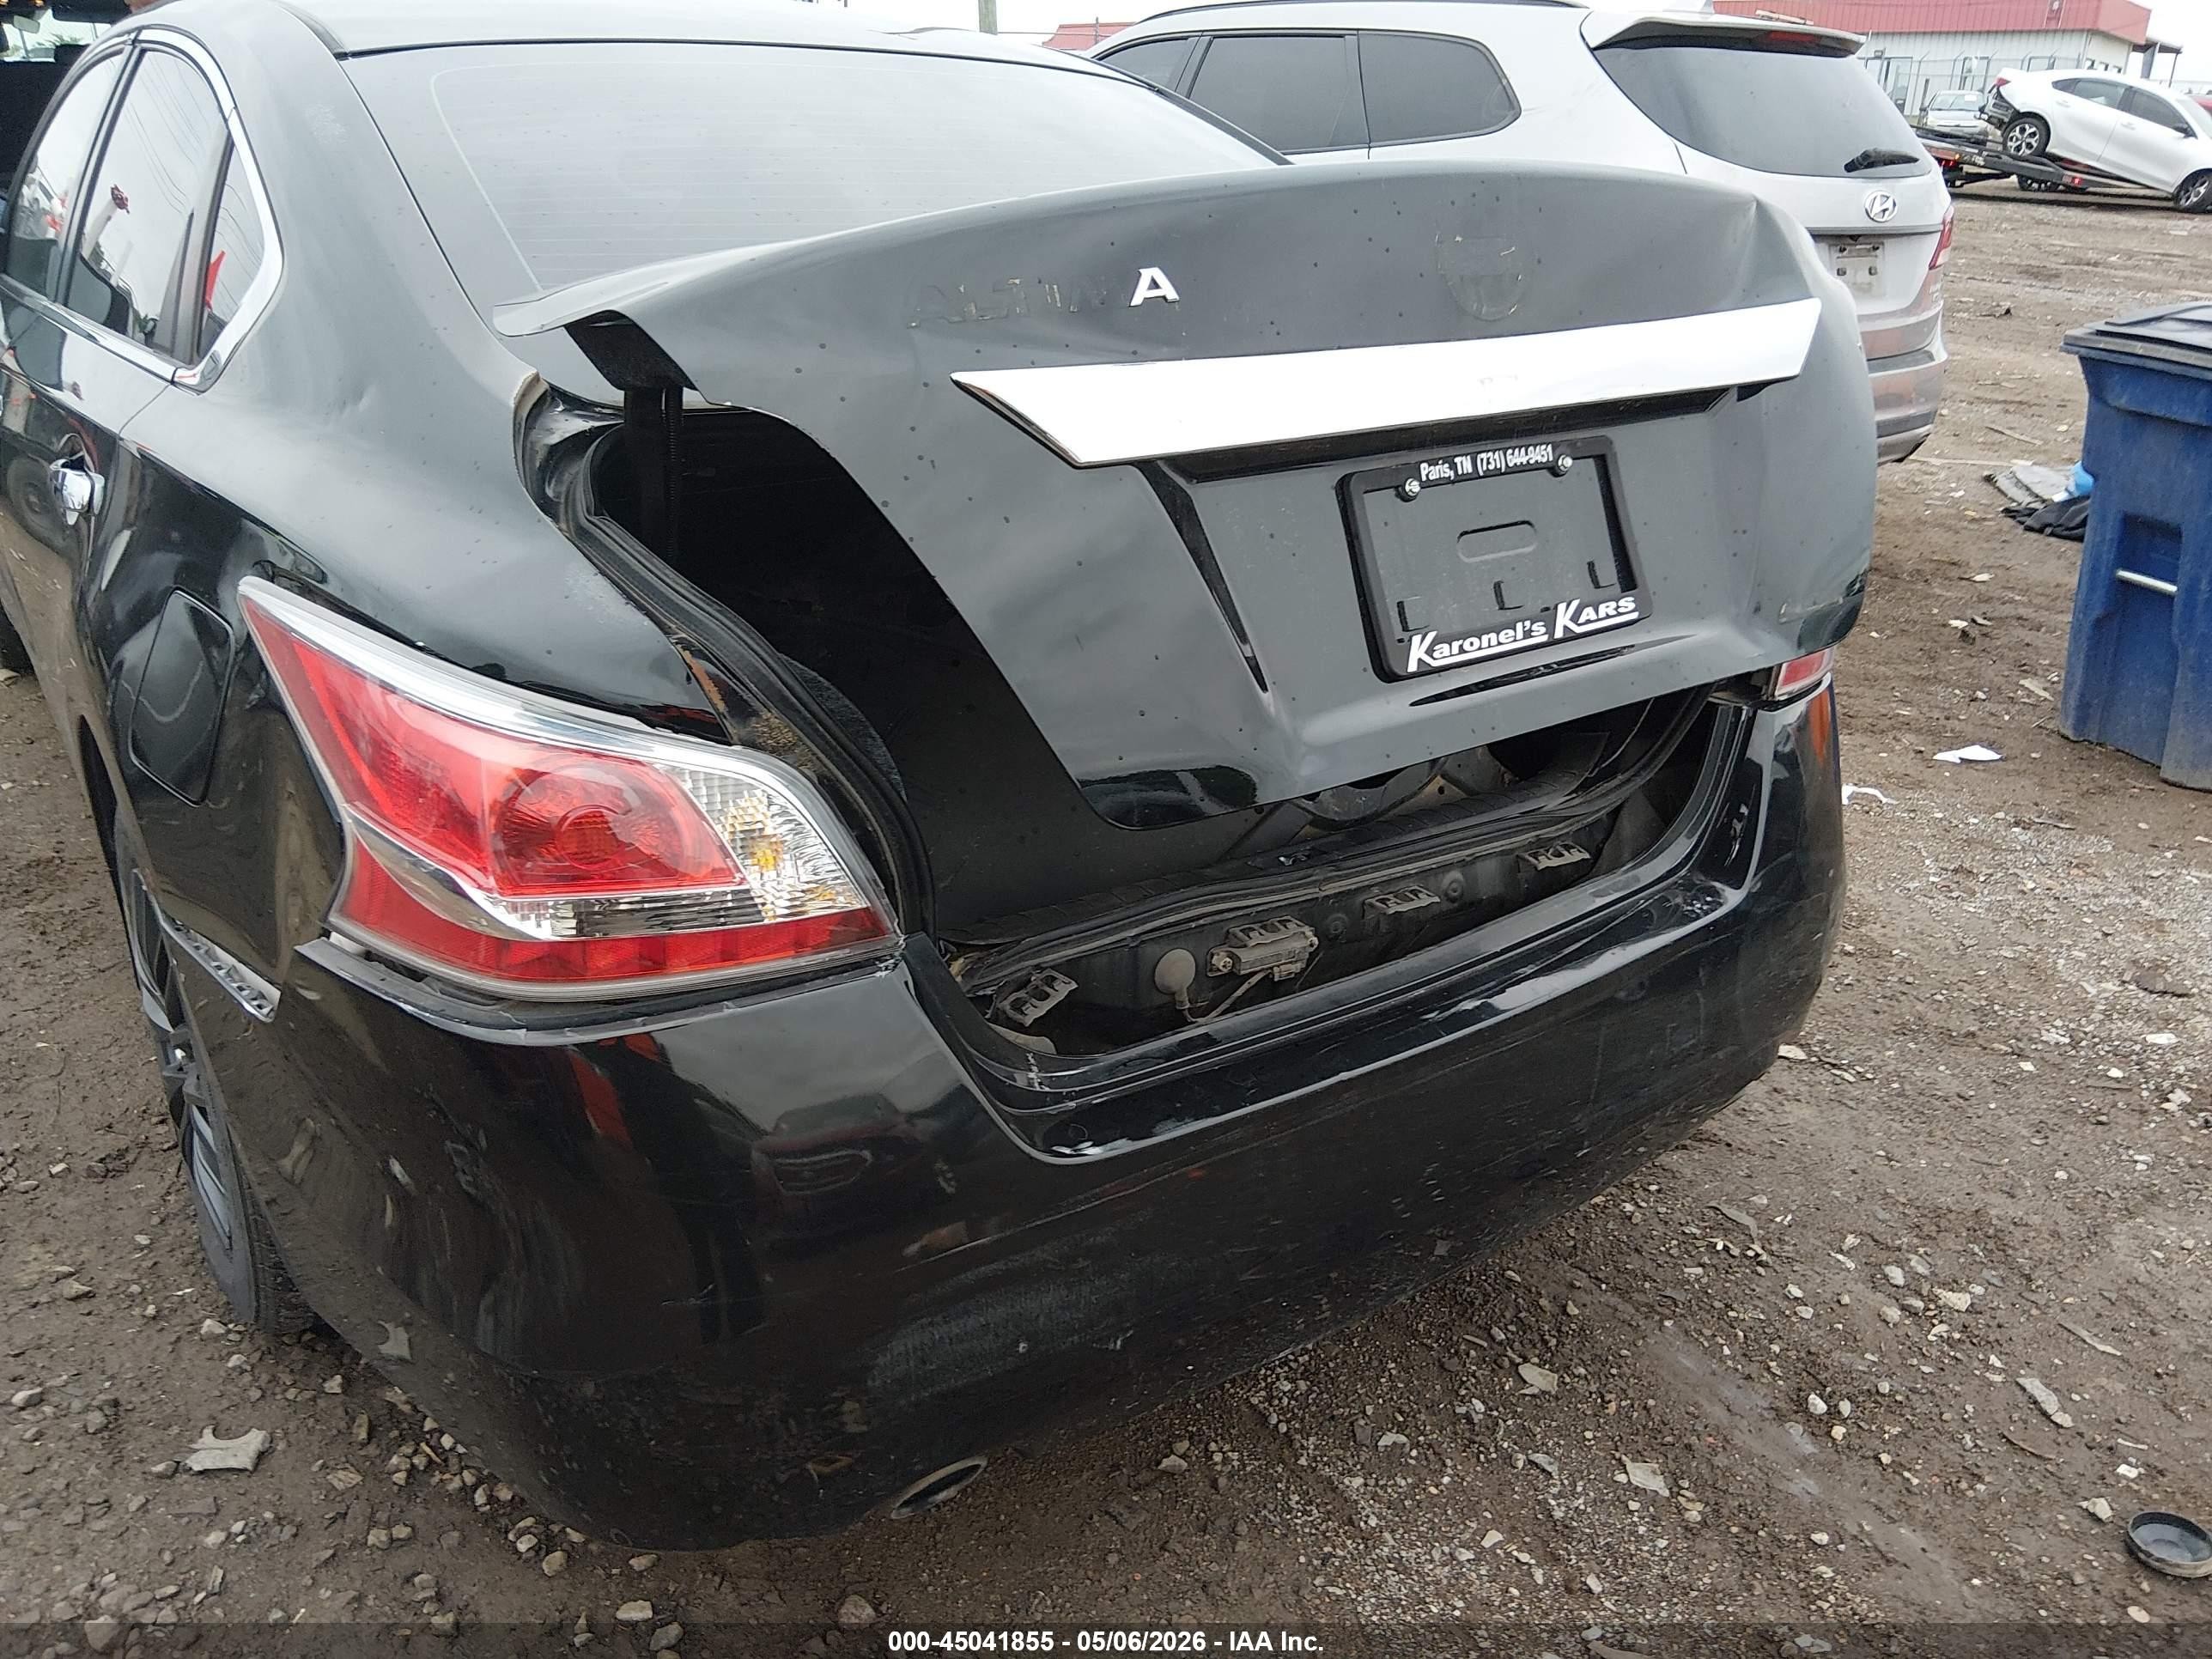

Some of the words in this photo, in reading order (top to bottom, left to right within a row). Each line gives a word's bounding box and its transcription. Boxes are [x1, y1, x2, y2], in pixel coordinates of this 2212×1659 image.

[1419, 459, 1455, 482] Paris,
[1454, 455, 1473, 476] TN
[1476, 449, 1505, 477] (731)
[1506, 443, 1553, 467] 644-9451
[1407, 620, 1549, 672] Karonel's
[1553, 596, 1640, 640] KARS
